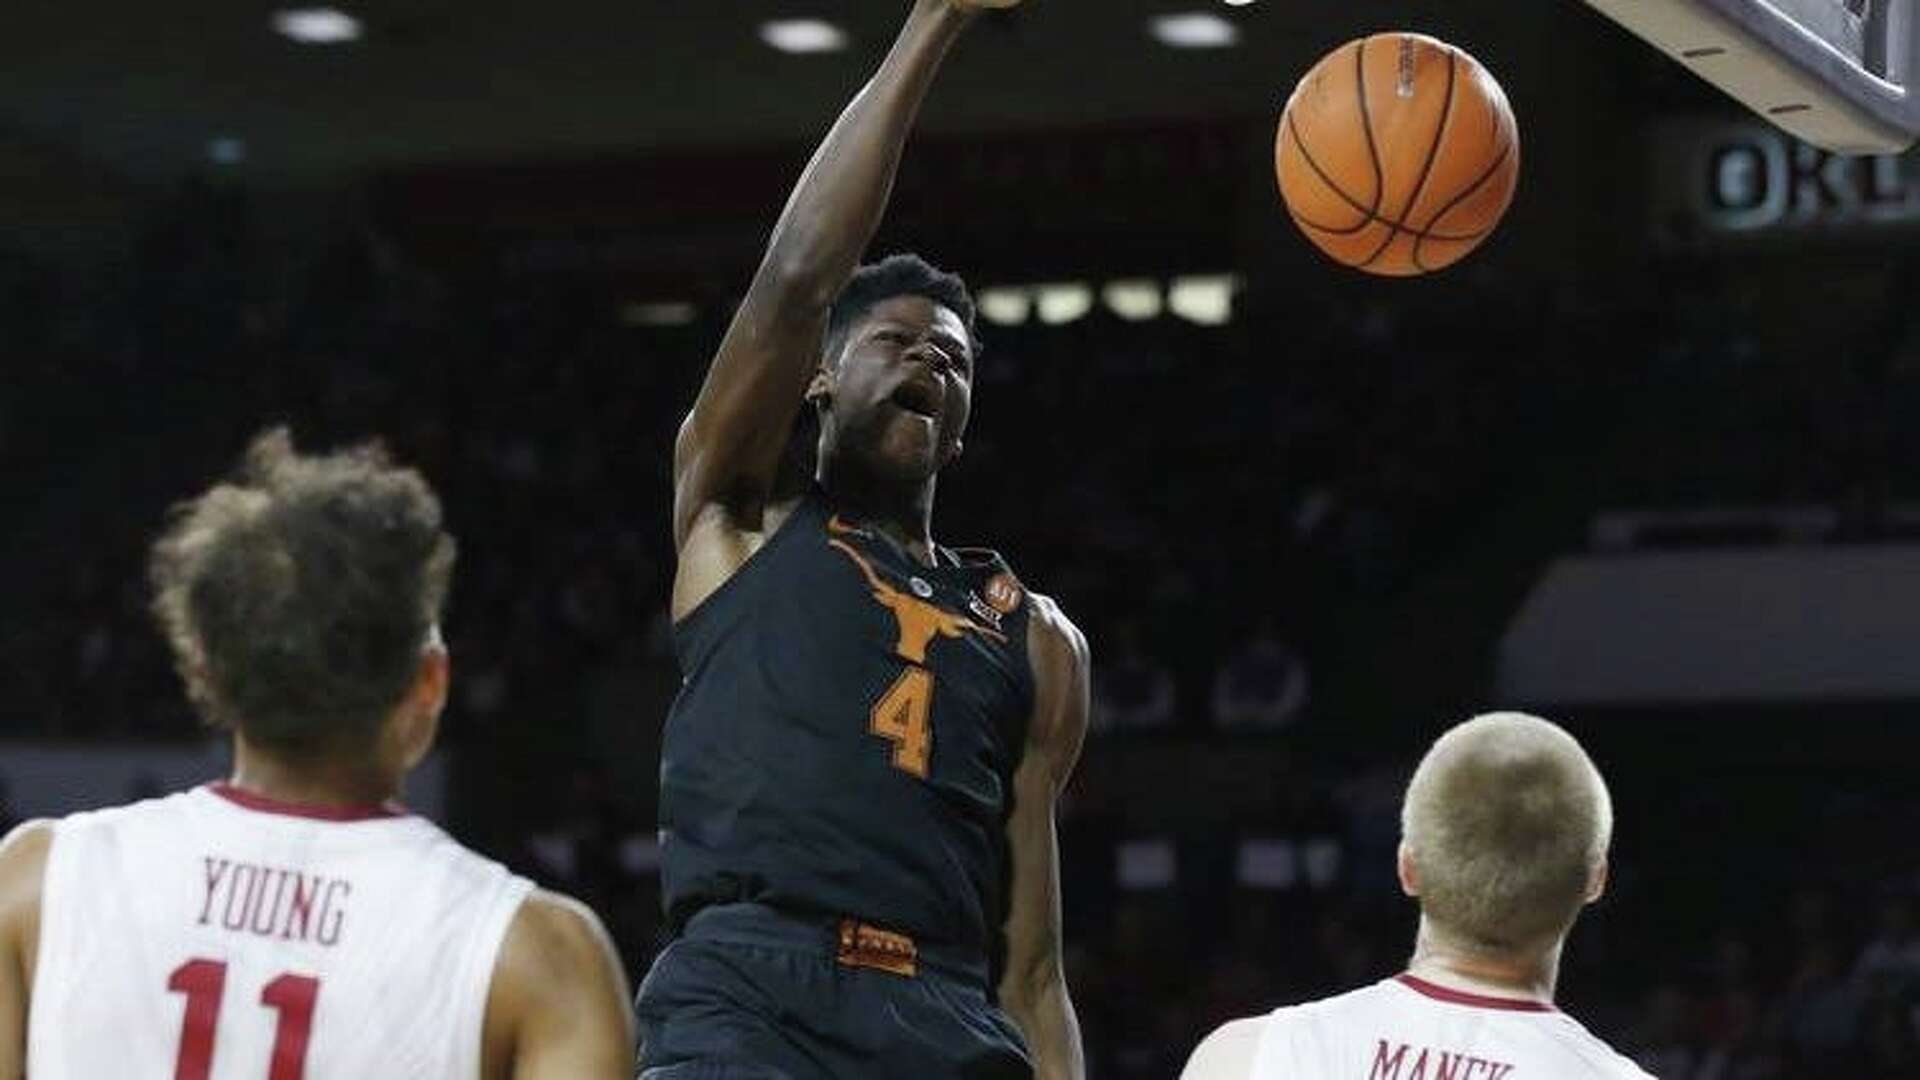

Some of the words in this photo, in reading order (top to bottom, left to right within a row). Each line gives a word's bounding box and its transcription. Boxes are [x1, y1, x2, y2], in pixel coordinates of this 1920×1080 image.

[869, 665, 933, 778] 4
[198, 857, 352, 946] YOUNG
[167, 957, 321, 1080] 11
